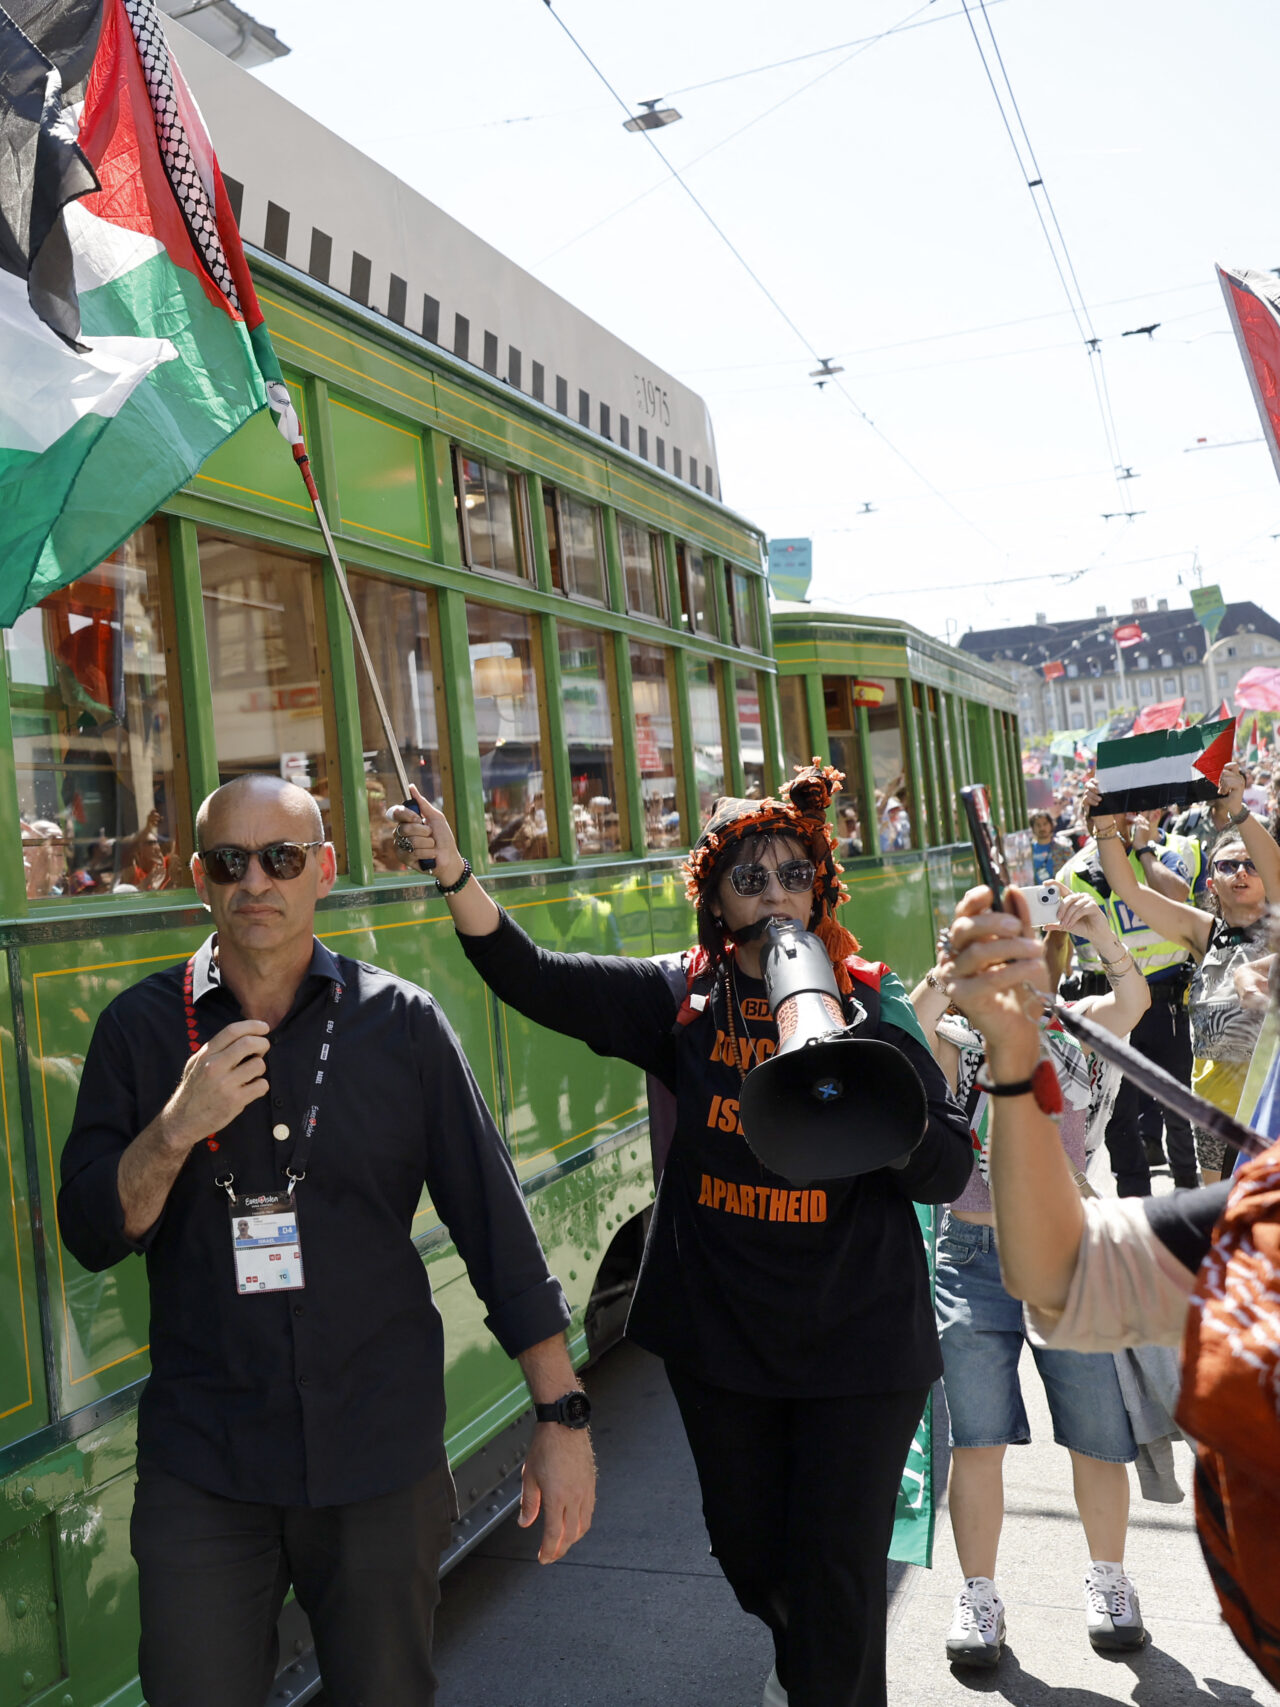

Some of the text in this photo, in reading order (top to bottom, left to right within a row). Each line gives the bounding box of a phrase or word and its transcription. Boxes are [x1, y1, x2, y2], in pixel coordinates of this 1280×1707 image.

[745, 1000, 772, 1018] BD
[710, 1030, 781, 1070] BOYC
[698, 1173, 827, 1222] APARTHEID
